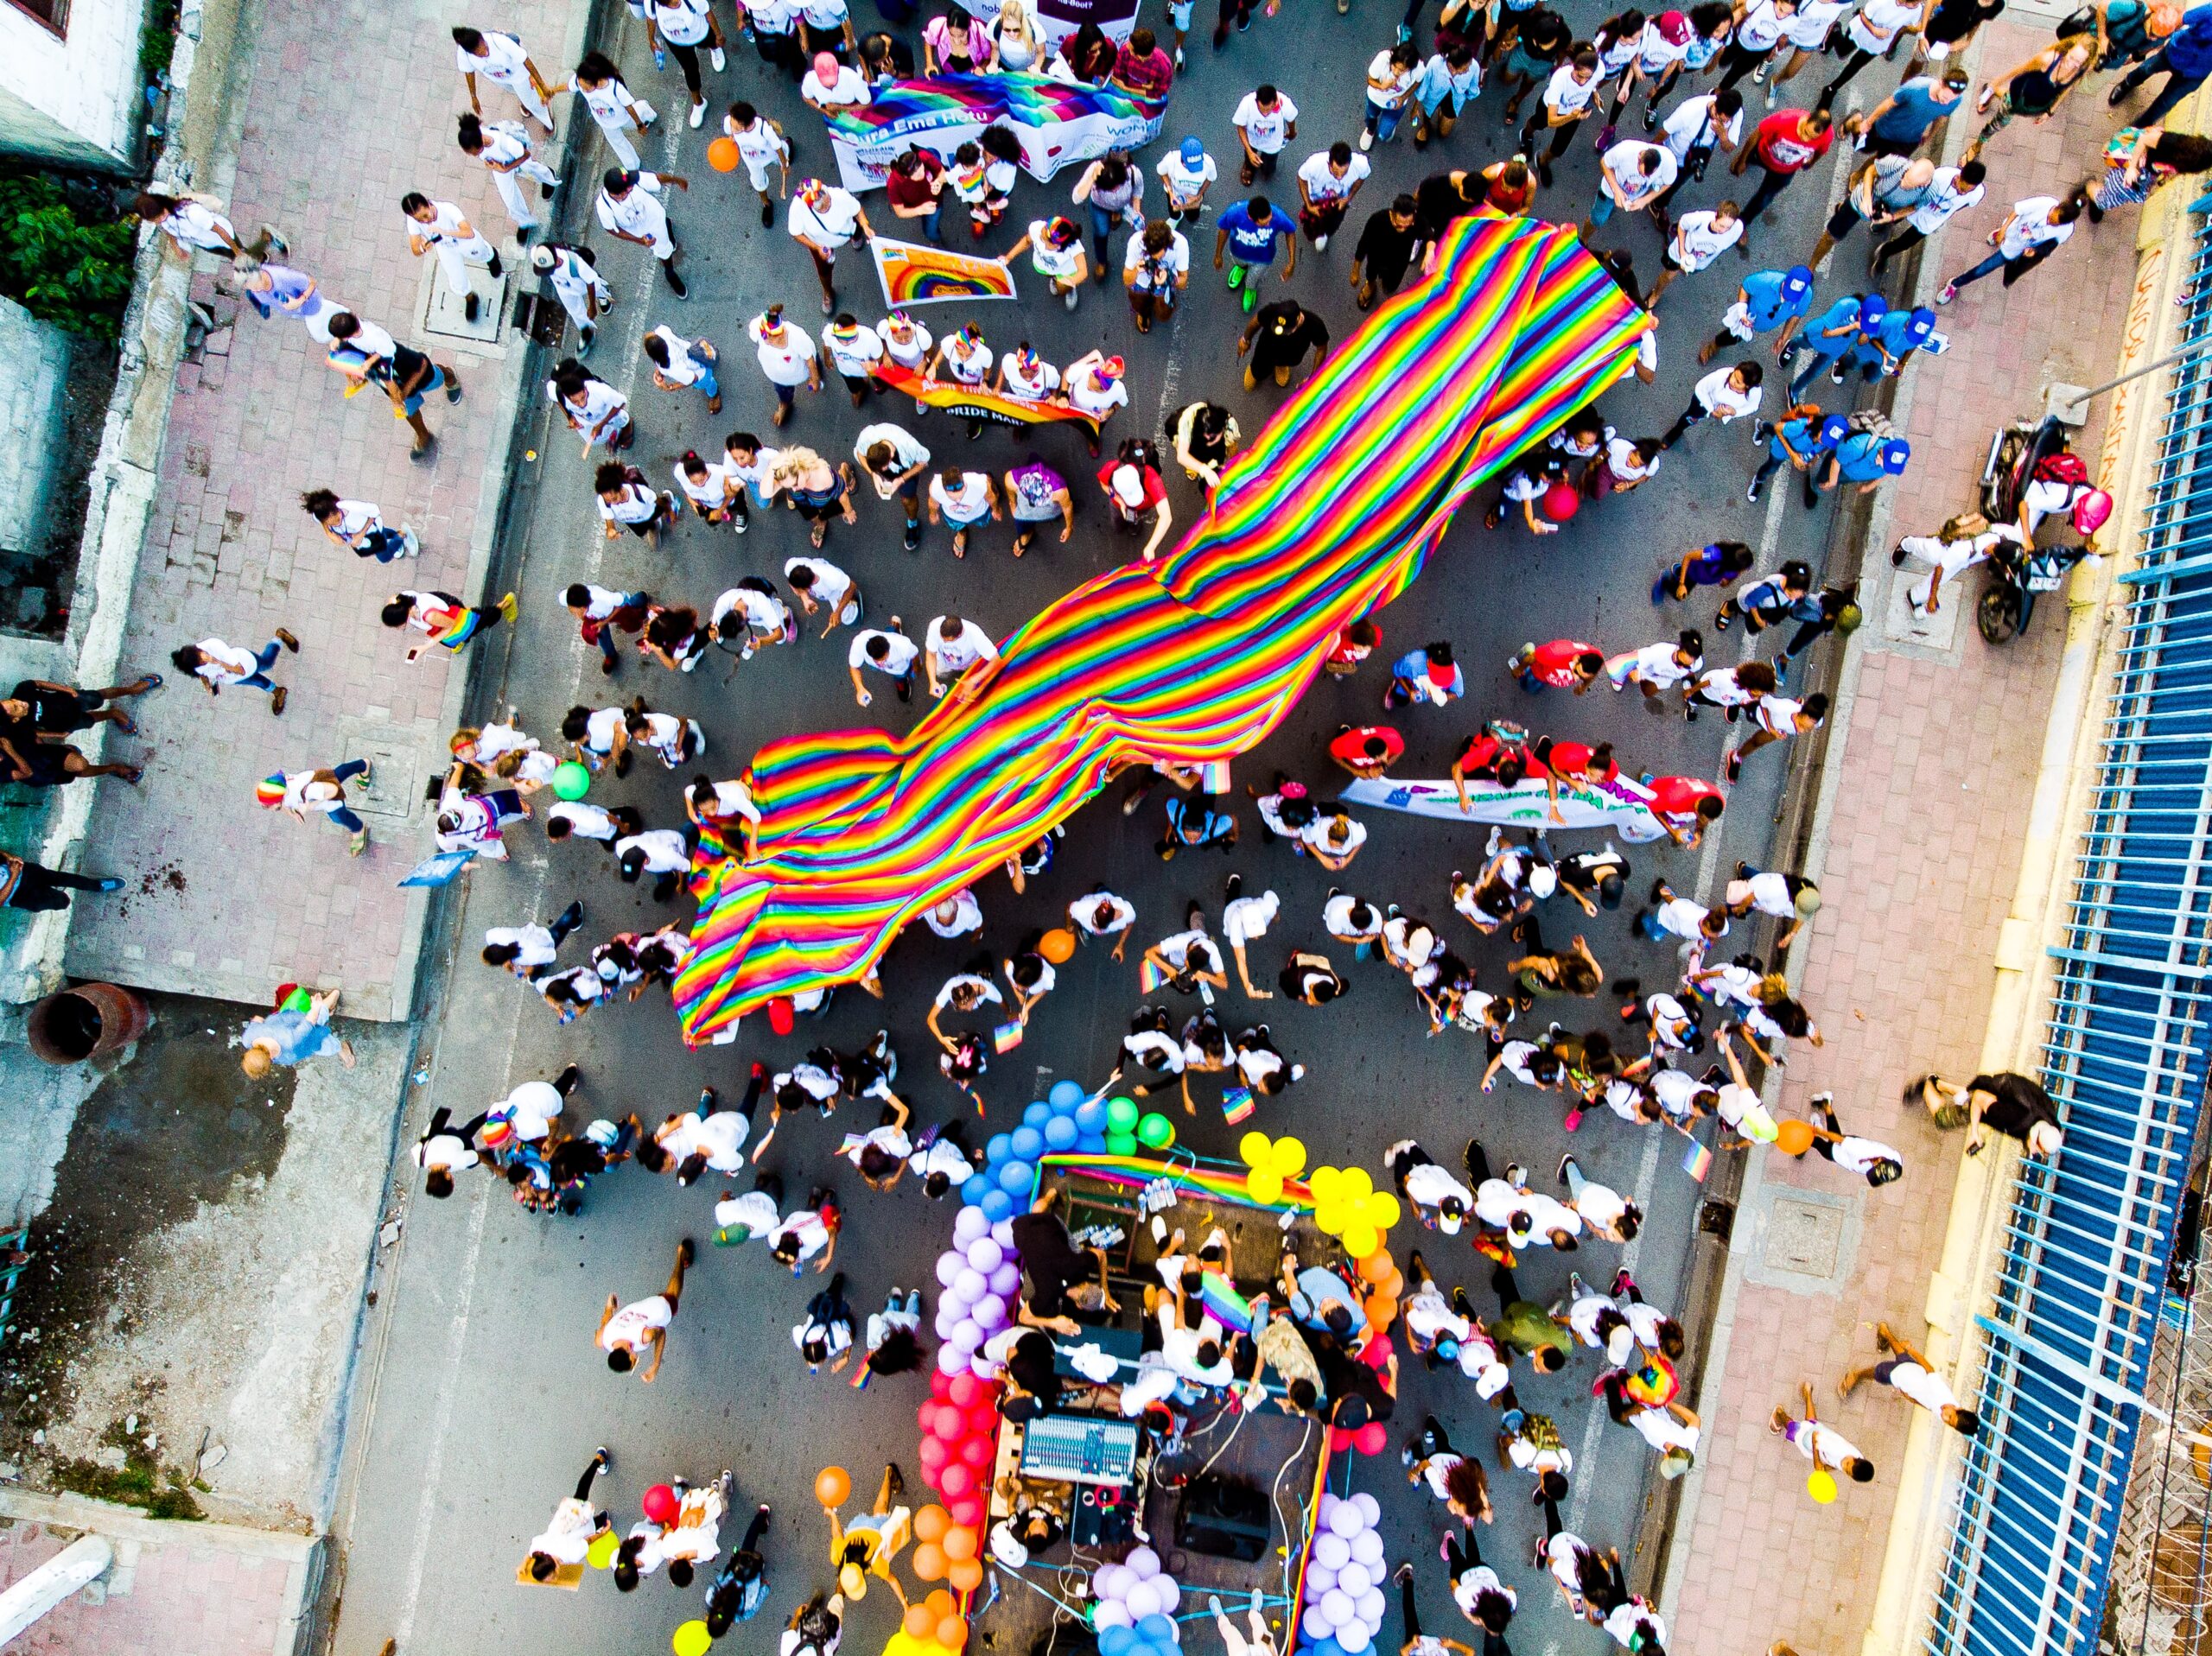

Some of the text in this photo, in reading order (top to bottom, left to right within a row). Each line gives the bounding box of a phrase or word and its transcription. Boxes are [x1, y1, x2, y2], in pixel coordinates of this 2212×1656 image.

[893, 115, 937, 133] Ema
[941, 108, 988, 125] Hotu
[946, 406, 1025, 427] PRIDE MAR
